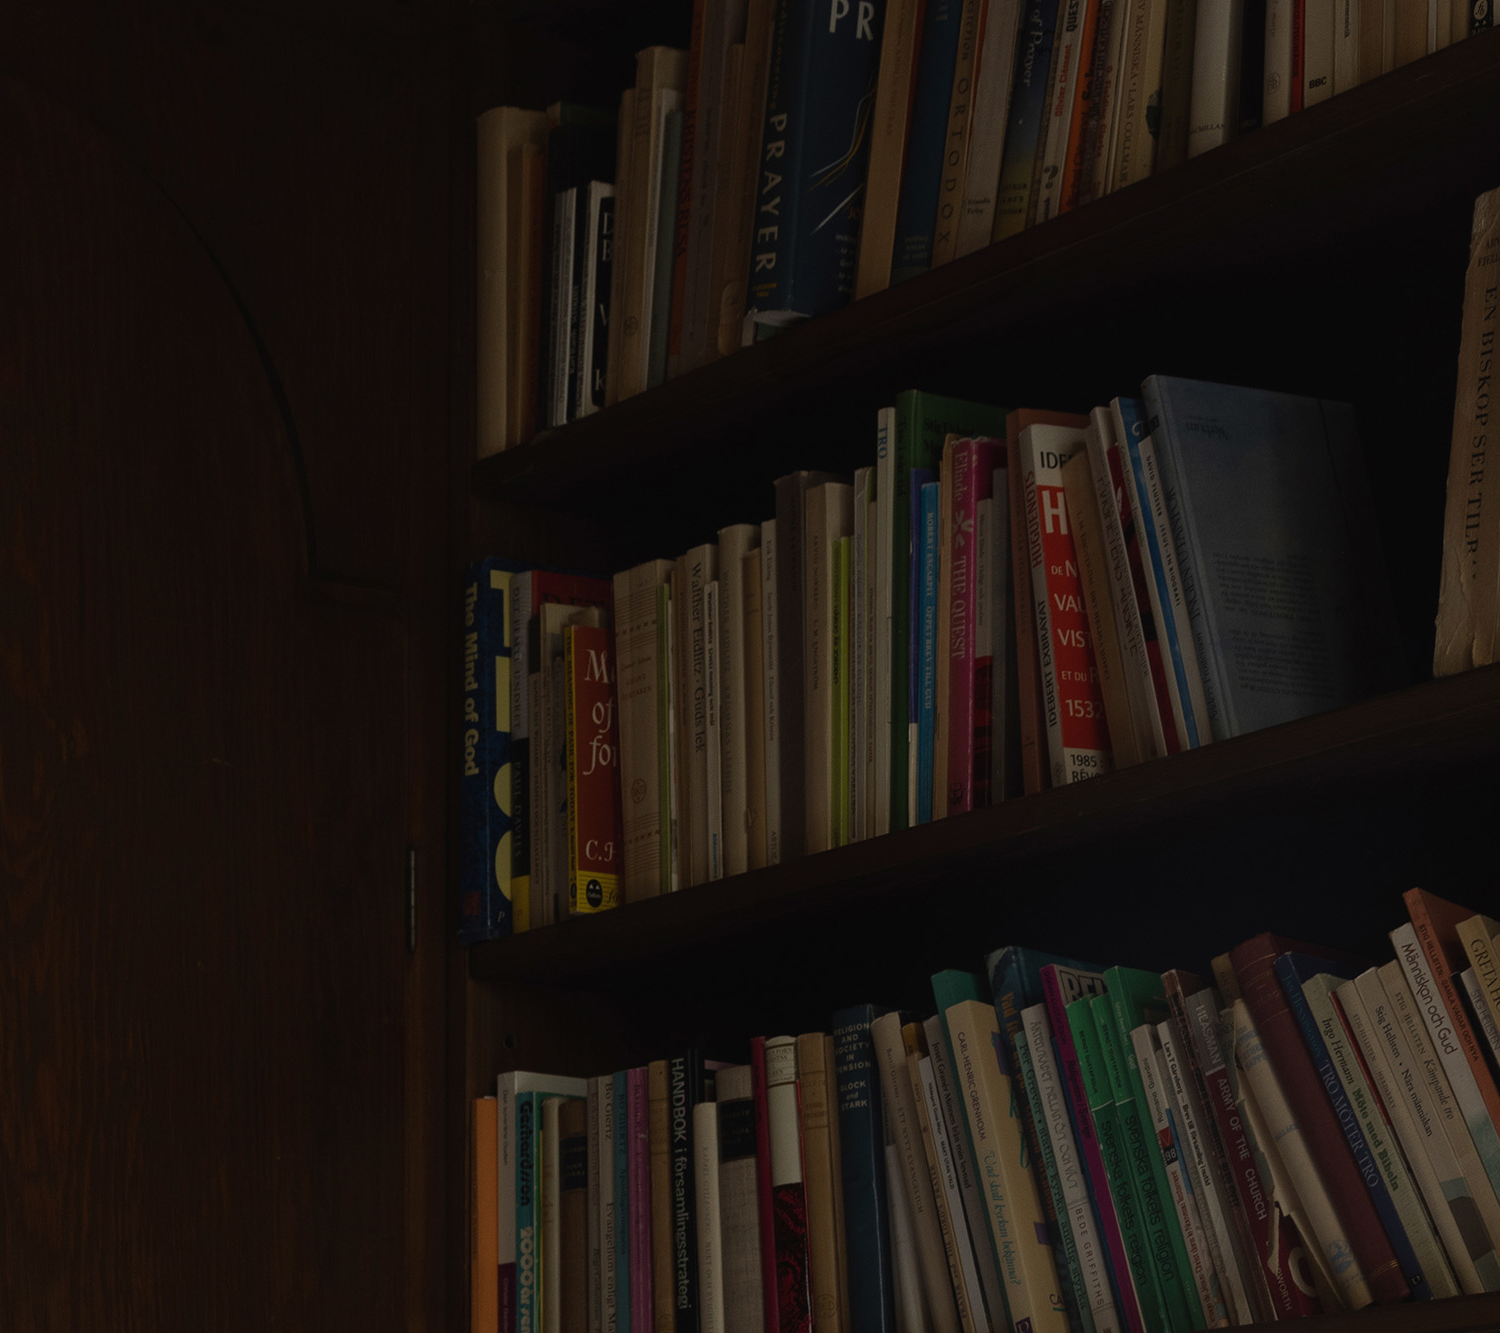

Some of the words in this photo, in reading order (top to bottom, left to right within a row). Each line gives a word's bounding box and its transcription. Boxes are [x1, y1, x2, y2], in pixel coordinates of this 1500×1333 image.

[1028, 9, 1043, 25] of
[1023, 31, 1044, 87] Prayer
[1130, 15, 1145, 79] MÄNNISKA
[1126, 89, 1136, 119] LARS
[1308, 76, 1327, 89] BBC
[877, 425, 890, 460] TRO
[953, 449, 968, 502] Eliade
[1023, 470, 1043, 569] HUGUENOTS
[690, 562, 704, 622] Walther
[951, 555, 967, 595] THE
[464, 581, 478, 627] The
[950, 597, 966, 660] QUEST
[1037, 599, 1051, 666] EXBRAYAT
[463, 634, 479, 695] Mind
[692, 628, 706, 676] Eidlitz
[463, 701, 479, 725] of
[693, 687, 707, 729] Guds
[1041, 666, 1058, 728] IDEBERT
[463, 728, 479, 777] God
[694, 732, 707, 754] lek
[1070, 754, 1097, 767] 1985
[514, 762, 522, 792] PAUL
[514, 802, 523, 858] DAVIES
[1469, 938, 1496, 994] GRETA
[1417, 924, 1429, 942] STIG
[1425, 941, 1444, 977] HELLSTEN
[1441, 978, 1455, 1004] GAMLA
[1450, 1004, 1466, 1031] VÄGAR
[1460, 1030, 1472, 1046] OCH
[1467, 1045, 1480, 1063] NYA
[834, 1022, 870, 1036] RELIGION
[835, 1041, 870, 1056] SOCIETY
[841, 1033, 859, 1043] AND
[1193, 1003, 1222, 1065] HEASMAN
[1320, 1017, 1339, 1040] Ingo
[1426, 1005, 1445, 1029] och
[1436, 1027, 1458, 1057] Gud
[846, 1053, 855, 1062] IN
[956, 1031, 975, 1089] CARL-HENRIC
[1329, 1040, 1356, 1085] Hermann
[1374, 1004, 1389, 1022] Stig
[1382, 1022, 1403, 1060] Hellsten
[1400, 1068, 1415, 1092] Nära
[1408, 1092, 1435, 1137] människan
[604, 1083, 614, 1097] Bo
[670, 1058, 687, 1142] HANDBOK
[846, 1091, 859, 1100] and
[1350, 1087, 1369, 1120] Möte
[1422, 1057, 1450, 1107] Kämpande
[604, 1099, 614, 1141] Giertz
[841, 1100, 868, 1112] STARK
[969, 1089, 987, 1142] GRENHOLM
[1361, 1122, 1383, 1149] med
[982, 1150, 998, 1178] Vad
[1085, 1054, 1100, 1094] GUSTAFSSON
[1100, 1120, 1125, 1180] svenska
[1115, 1181, 1137, 1231] folkets
[1127, 1233, 1149, 1287] religion
[1373, 1151, 1399, 1193] Bibeln
[987, 1179, 1002, 1202] skall
[1123, 1116, 1148, 1176] svenska
[1138, 1176, 1163, 1227] folkets
[1153, 1228, 1176, 1282] religion
[605, 1202, 616, 1274] Evangelium
[673, 1156, 692, 1310] församlingsstrategi
[992, 1204, 1011, 1239] kyrkan
[520, 1226, 534, 1286] 2000
[1001, 1240, 1021, 1286] bekänna?
[1075, 1207, 1088, 1238] BEDE
[1084, 1242, 1106, 1306] GRIFFITHS
[520, 1287, 534, 1309] år
[605, 1276, 617, 1310] enligt
